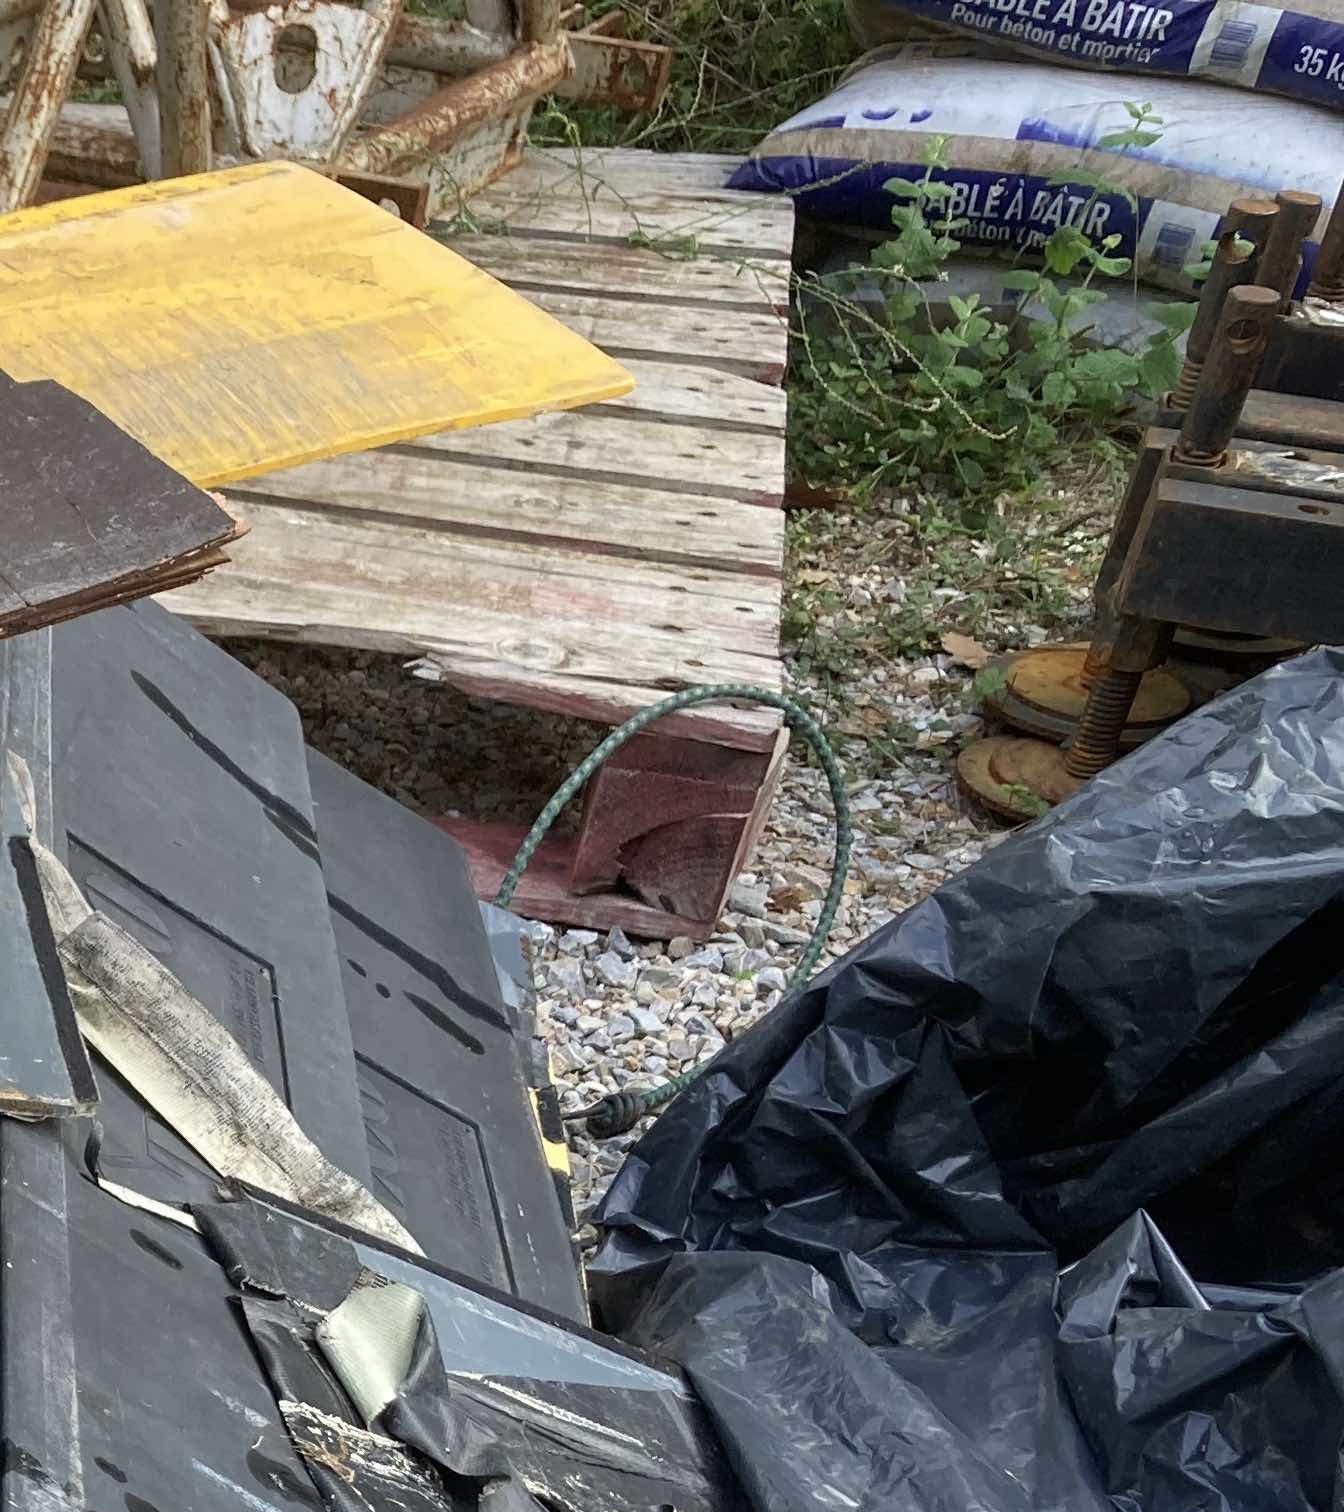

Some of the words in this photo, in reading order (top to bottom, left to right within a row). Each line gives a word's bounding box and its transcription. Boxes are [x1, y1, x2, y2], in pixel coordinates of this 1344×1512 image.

[951, 3, 998, 29] Pour
[1000, 14, 1056, 45] béton
[1058, 32, 1081, 51] et
[1081, 39, 1161, 64] mortier
[1293, 44, 1329, 77] 35
